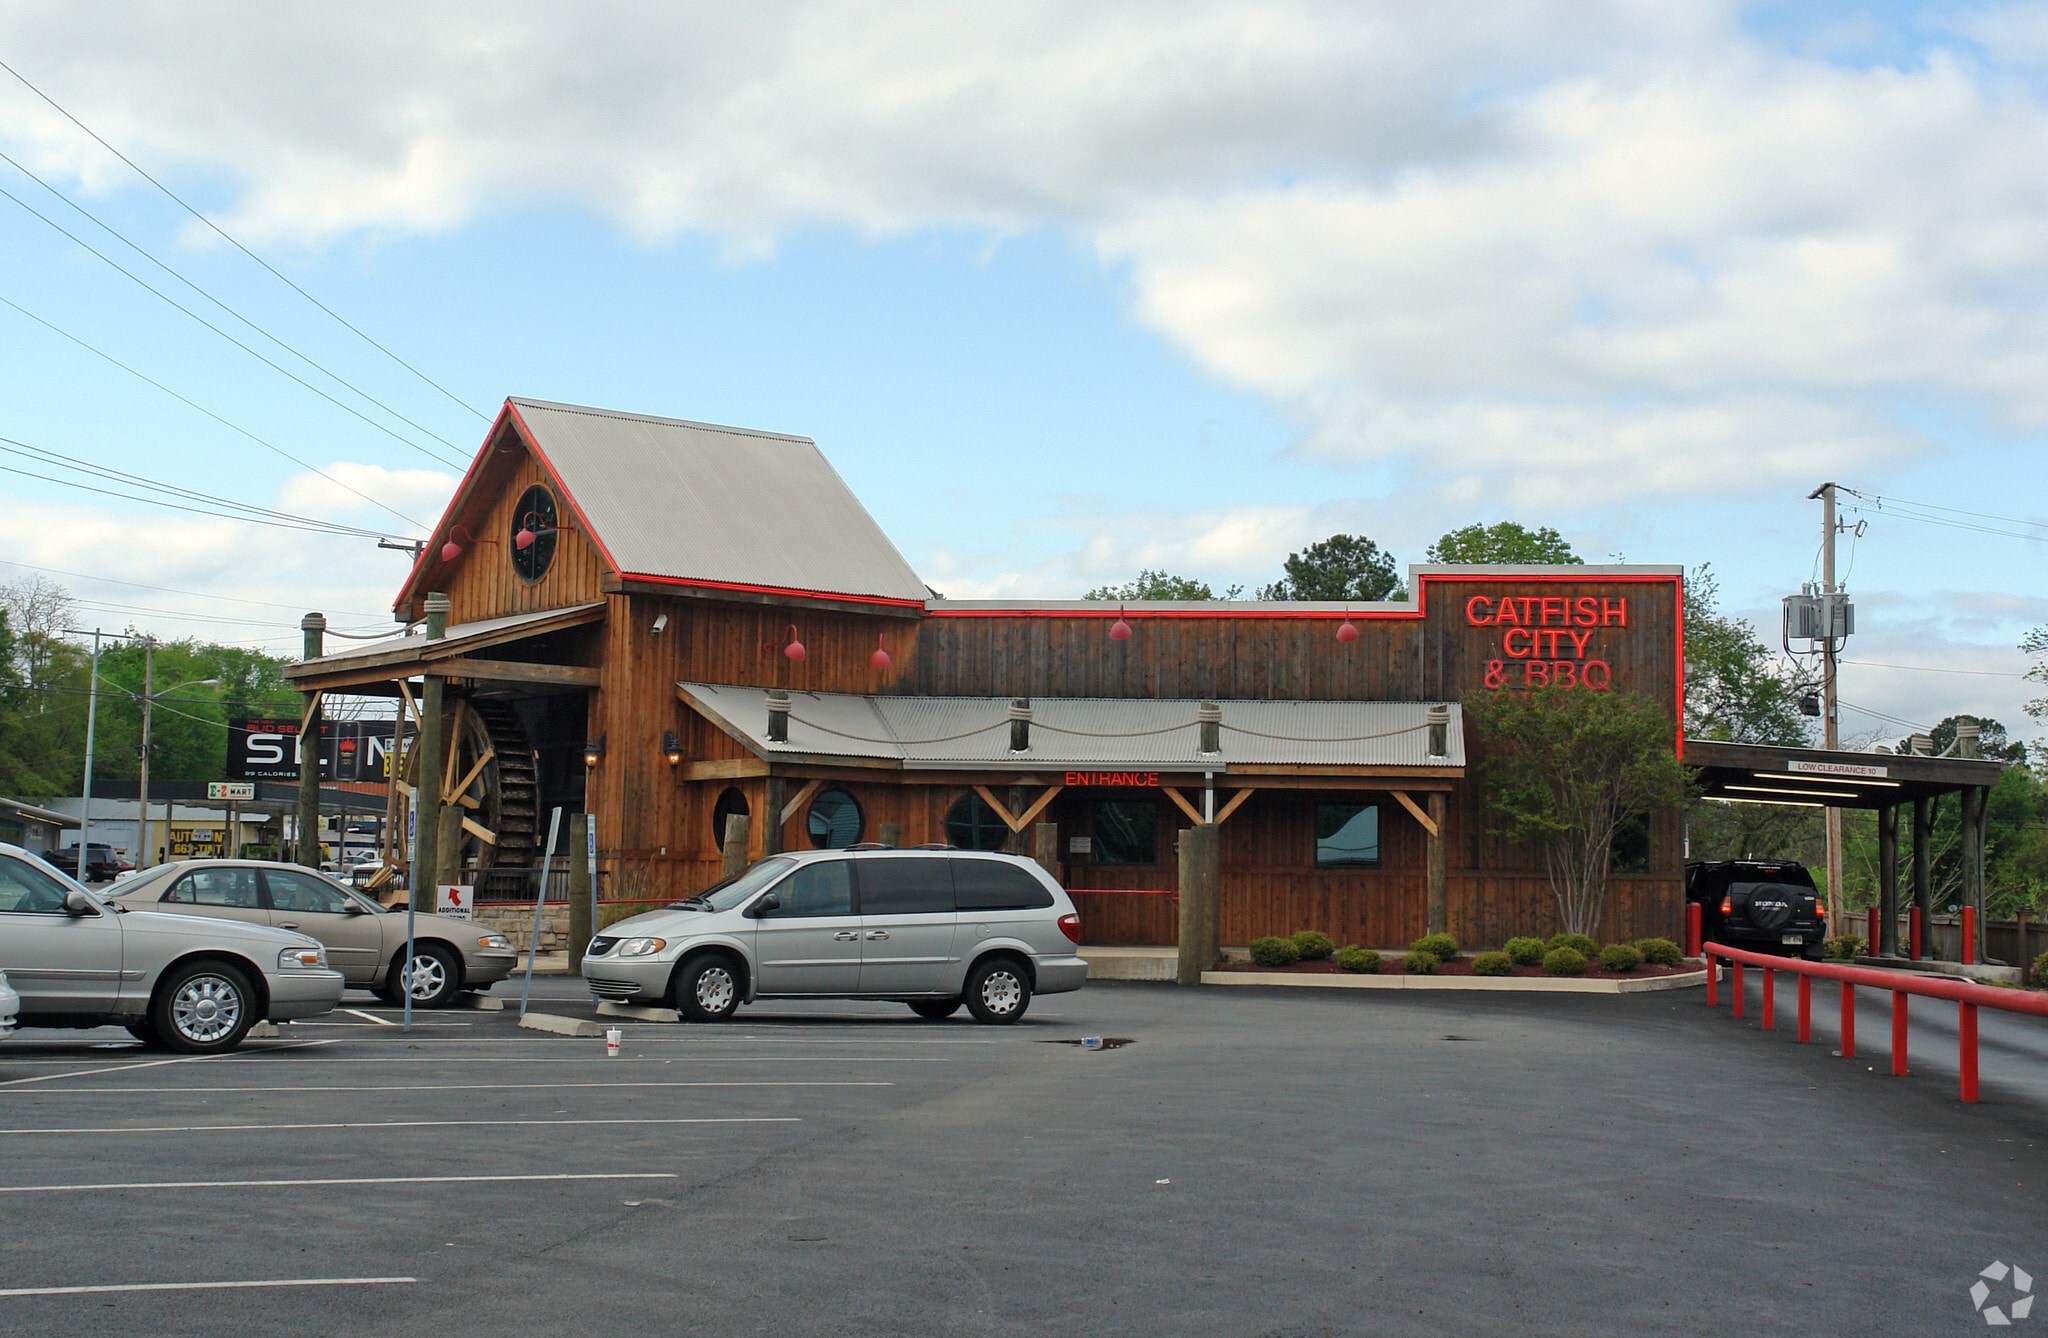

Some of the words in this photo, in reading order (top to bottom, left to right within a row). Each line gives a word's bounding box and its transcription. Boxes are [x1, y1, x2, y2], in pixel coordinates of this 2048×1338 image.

[1466, 595, 1627, 627] CATFISH
[1503, 628, 1592, 659] CITY
[1484, 660, 1509, 690] &
[1525, 660, 1612, 692] BBQ
[246, 724, 275, 733] BUD
[1797, 763, 1816, 771] LOW
[1817, 764, 1866, 775] CLEARANCE
[1065, 771, 1160, 787] ENTRANCE
[209, 784, 228, 798] E-Z
